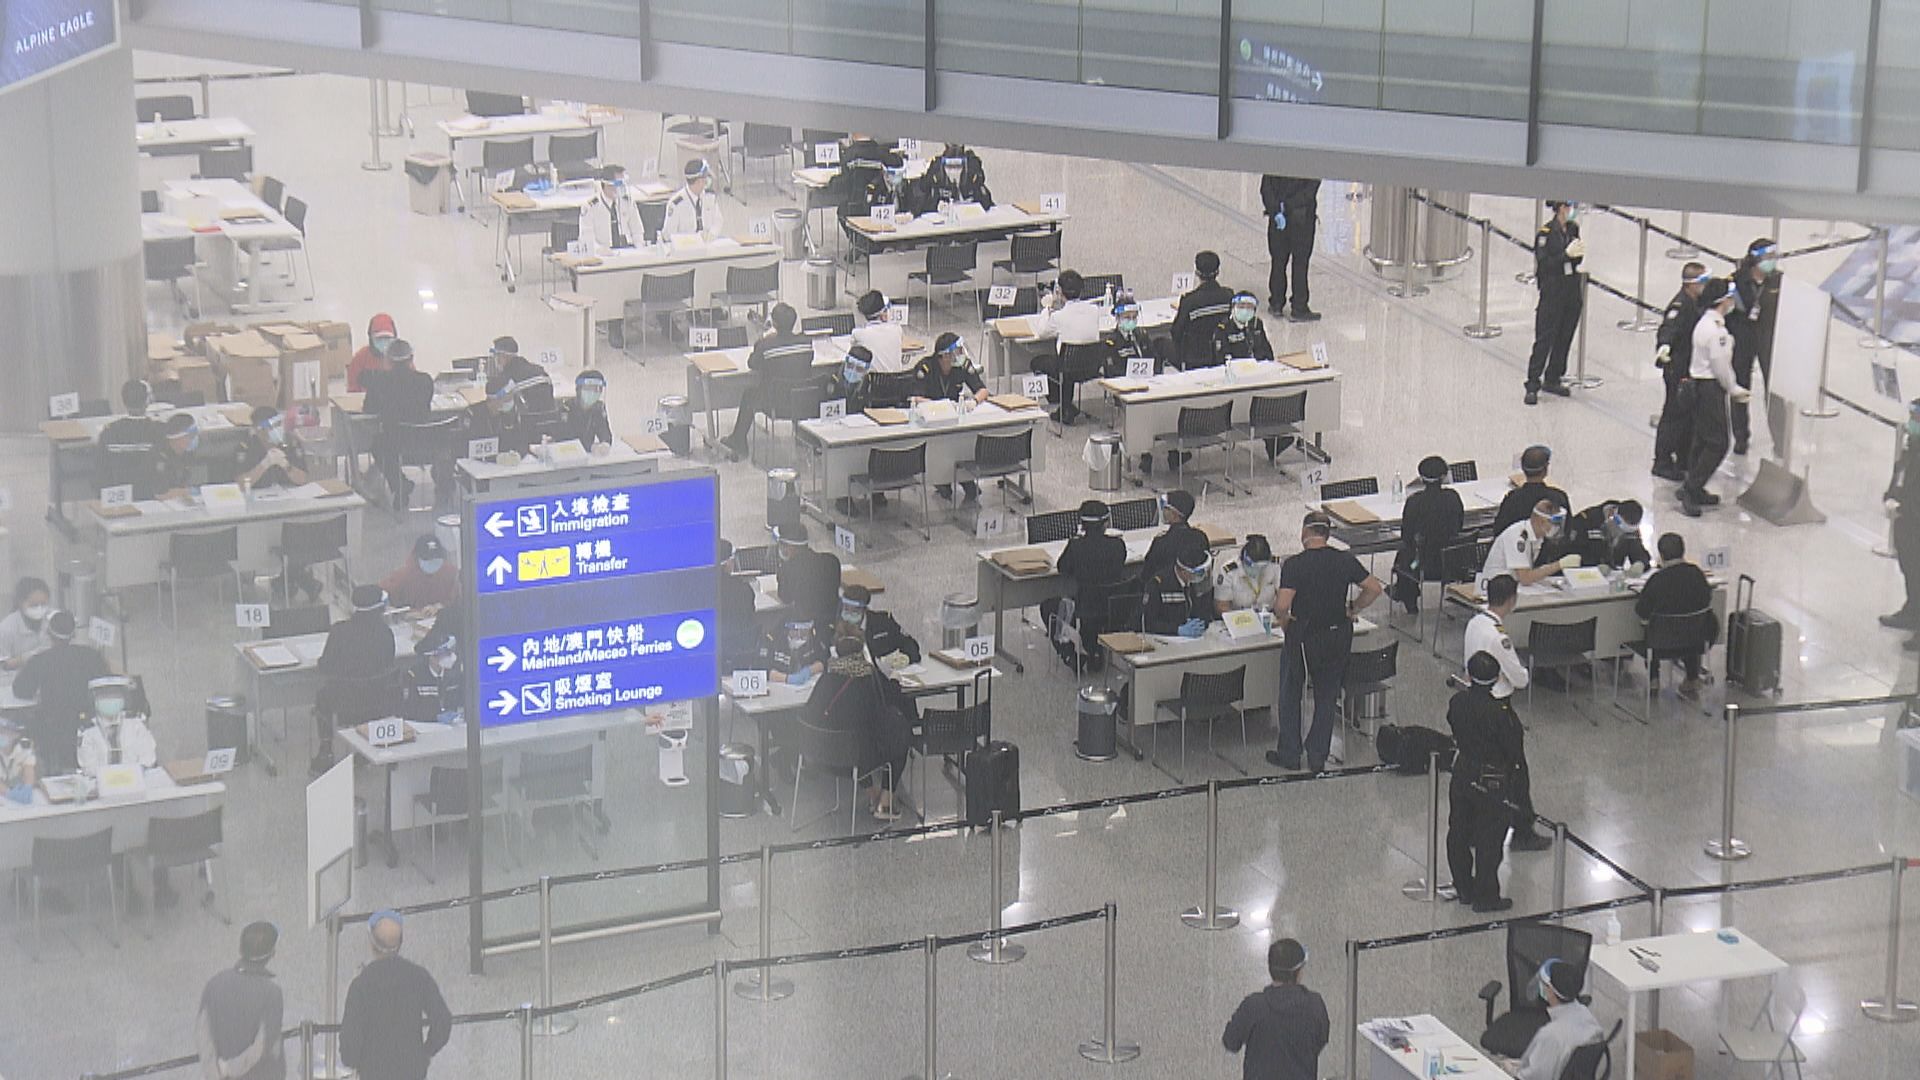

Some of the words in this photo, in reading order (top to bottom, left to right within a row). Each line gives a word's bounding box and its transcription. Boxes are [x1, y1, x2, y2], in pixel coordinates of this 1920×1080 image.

[16, 26, 56, 54] ALPINE
[60, 11, 94, 38] EAGLE
[820, 148, 834, 159] 47
[1046, 198, 1059, 209] 41
[875, 208, 890, 220] 42
[753, 222, 766, 234] 43
[1176, 277, 1188, 289] 31
[995, 287, 1011, 299] 32
[696, 332, 711, 344] 34
[541, 352, 557, 364] 35
[1131, 363, 1148, 375] 22
[1029, 380, 1043, 394] 23
[826, 405, 840, 418] 24
[647, 418, 662, 434] 25
[475, 442, 492, 454] 26
[1307, 470, 1322, 485] 12
[551, 512, 629, 533] Immigration
[984, 519, 997, 532] 14
[839, 534, 851, 549] 15
[576, 556, 628, 575] Transfer
[1707, 552, 1724, 567] 01
[244, 608, 262, 623] 18
[522, 647, 628, 671] Mainland/Macao
[631, 640, 672, 657] Ferries
[970, 642, 988, 657] 05
[740, 675, 759, 689] 06
[555, 692, 612, 710] Smoking
[615, 686, 662, 702] Lounge
[376, 724, 396, 739] 08
